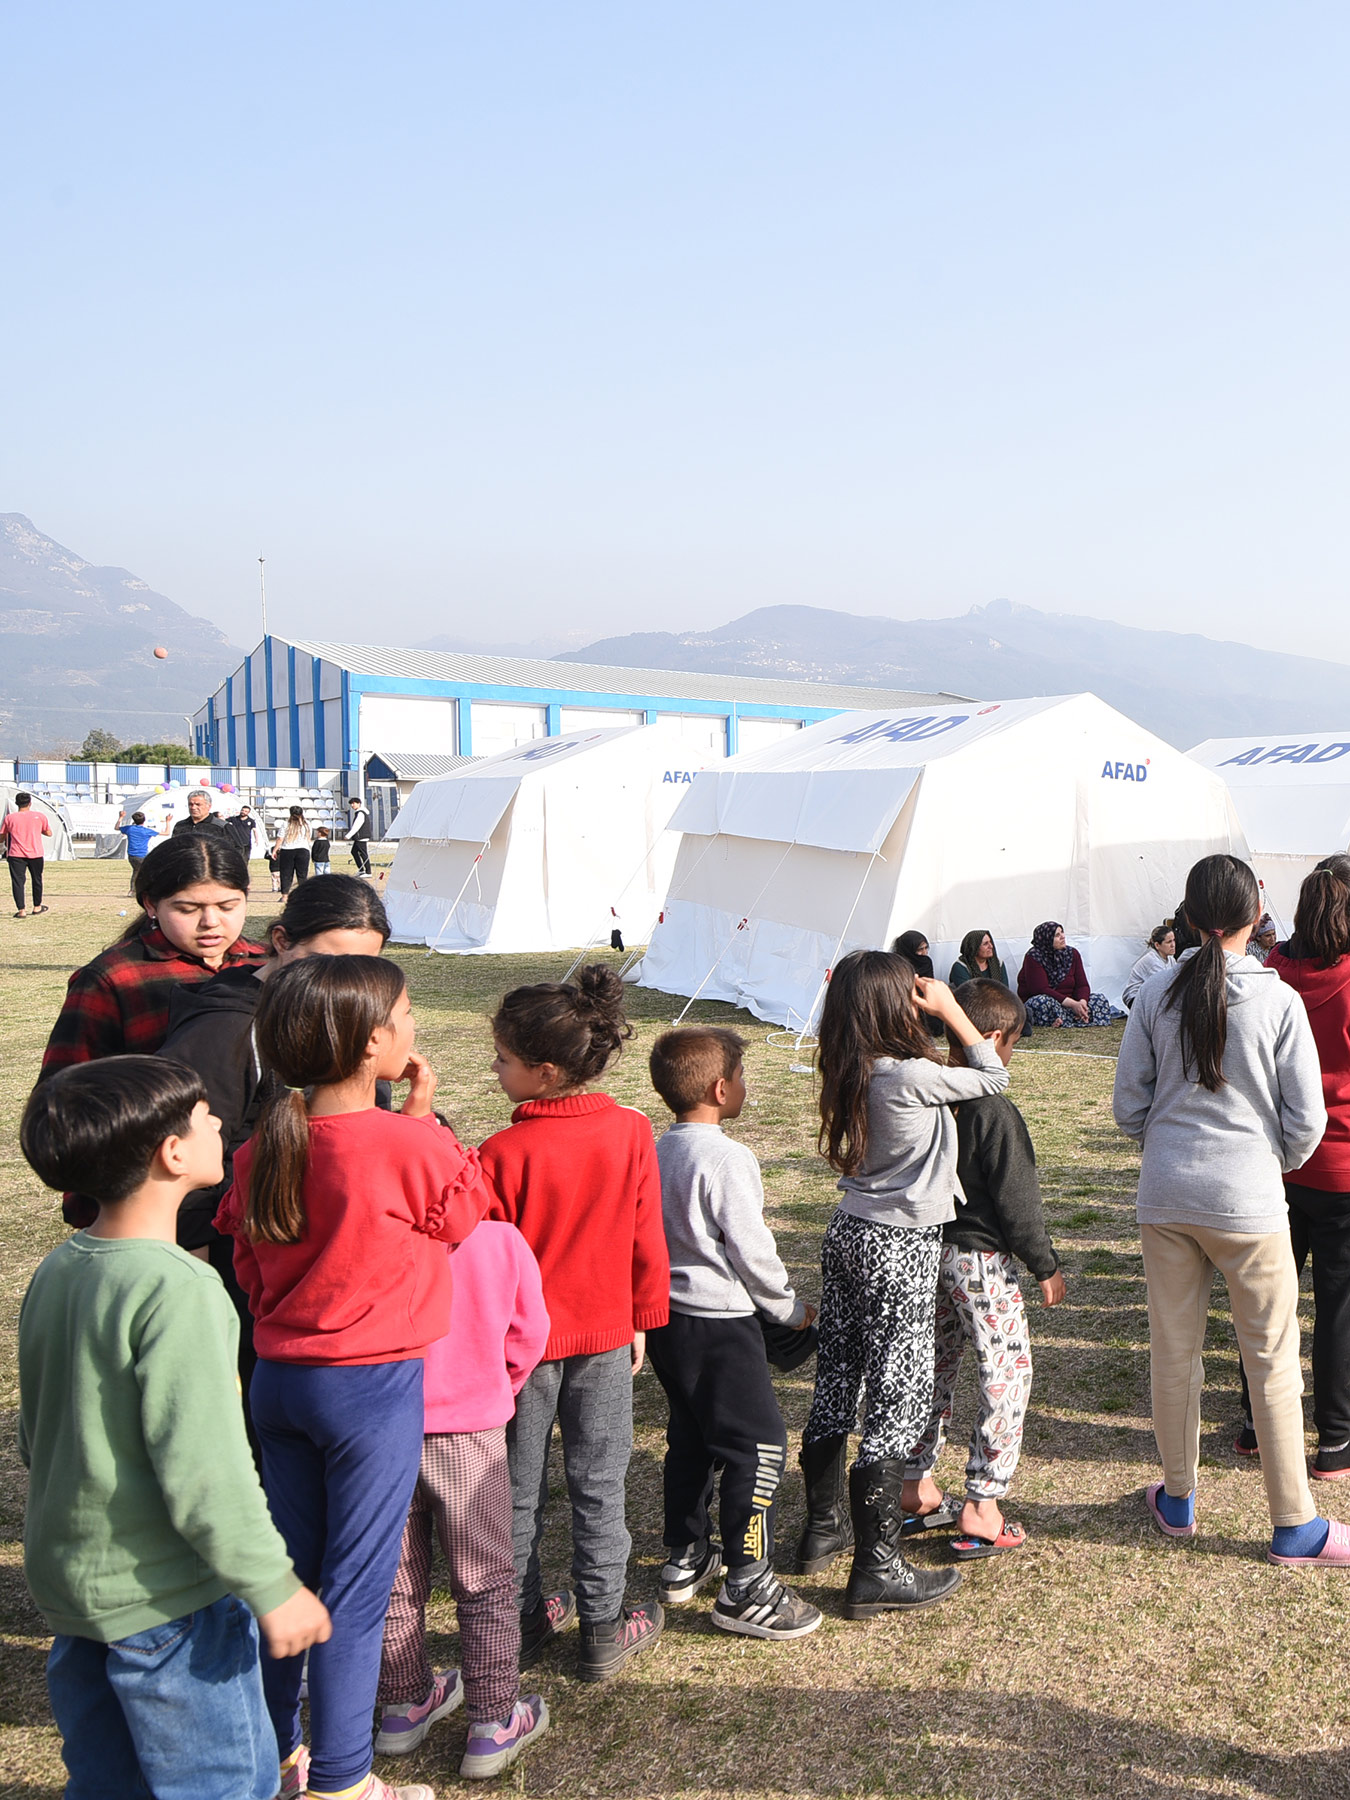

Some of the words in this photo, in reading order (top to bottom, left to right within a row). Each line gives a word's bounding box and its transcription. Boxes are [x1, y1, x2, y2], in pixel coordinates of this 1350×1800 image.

[824, 715, 970, 745] AFAD
[1101, 760, 1147, 782] AFAD
[743, 1513, 762, 1561] SPORT
